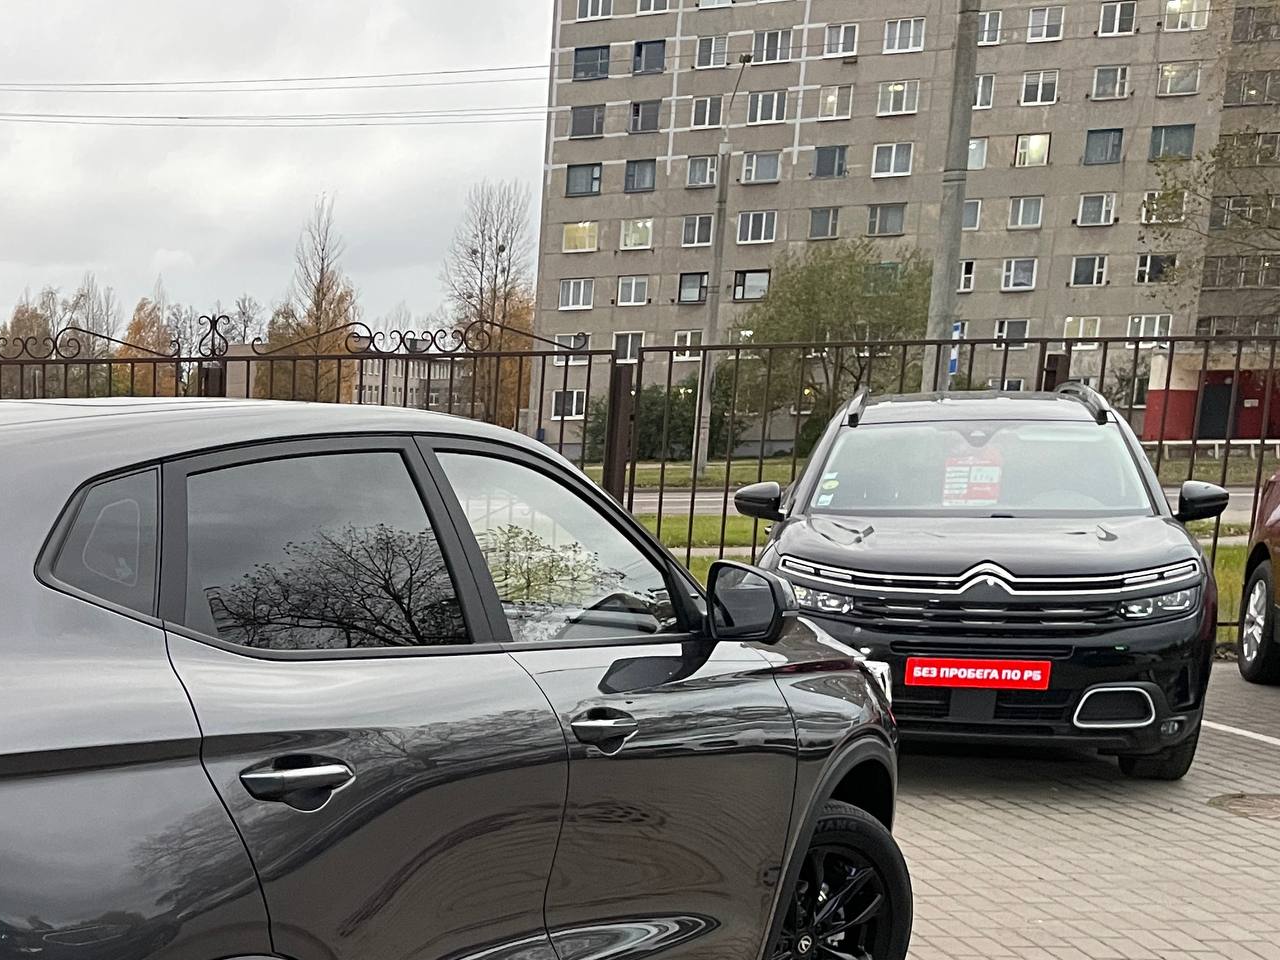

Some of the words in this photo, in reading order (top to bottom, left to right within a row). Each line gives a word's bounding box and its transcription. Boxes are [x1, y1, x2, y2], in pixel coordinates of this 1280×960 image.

[913, 666, 937, 678] БЕЗ
[940, 667, 999, 680] ПРОБЕГА
[1001, 669, 1021, 680] ПО
[1023, 670, 1042, 681] РБ
